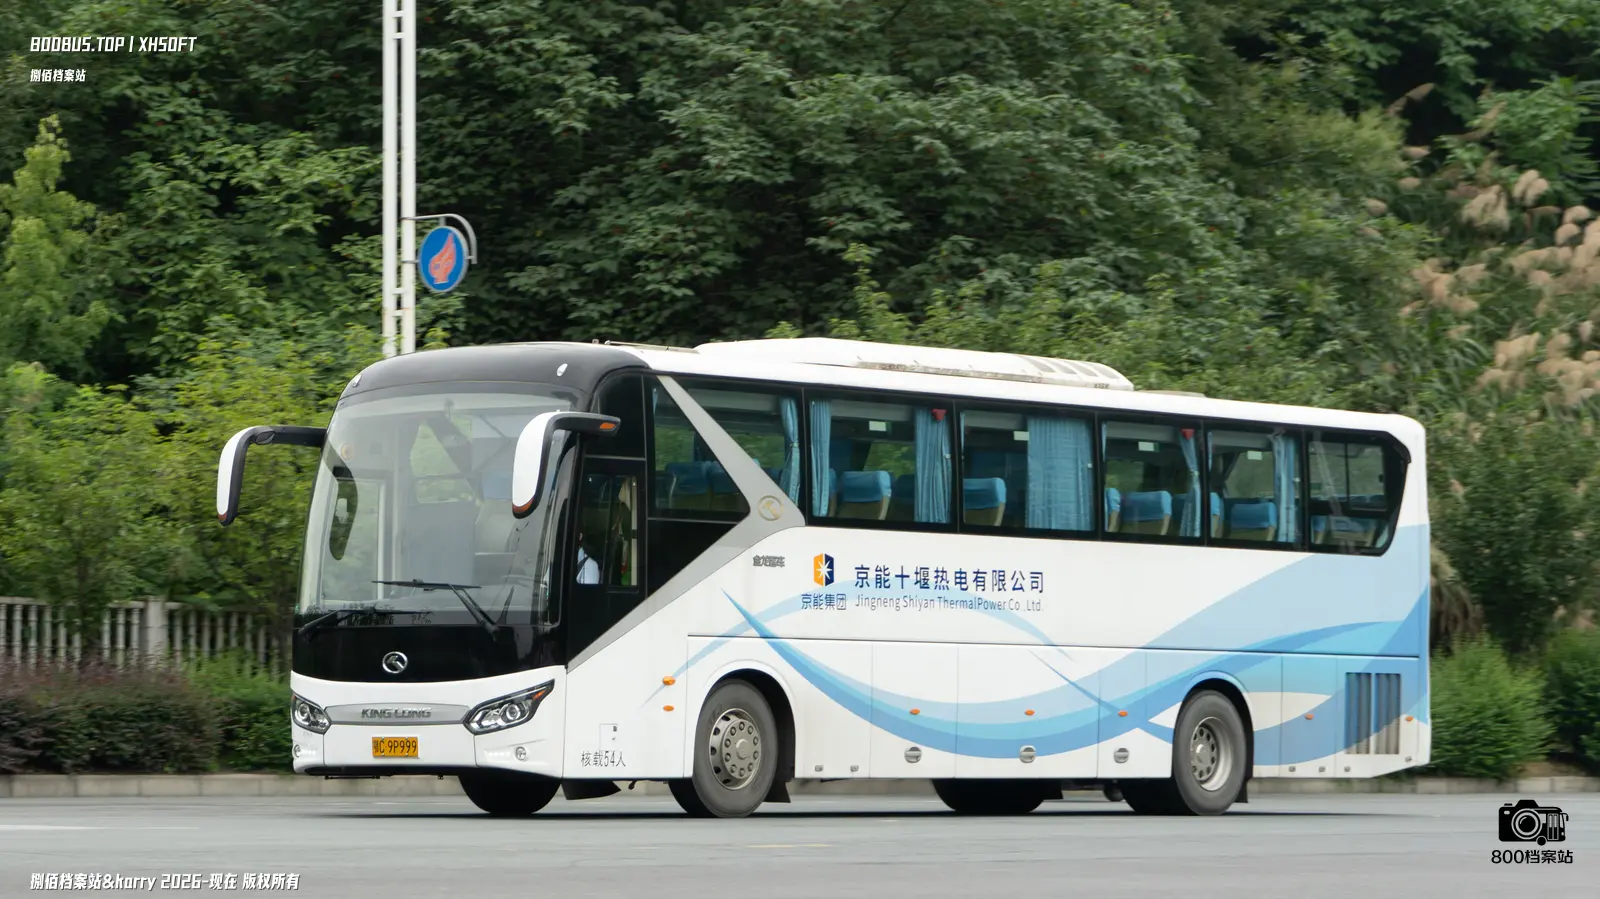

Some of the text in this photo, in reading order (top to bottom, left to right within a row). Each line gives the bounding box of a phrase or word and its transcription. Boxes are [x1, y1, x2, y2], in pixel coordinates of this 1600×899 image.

[854, 564, 1044, 593] 京能十堰热电有限公司
[800, 593, 847, 611] 京能集团
[855, 593, 901, 611] Jingneng
[902, 595, 935, 611] Shiyan
[361, 708, 431, 719] KING LONG
[580, 750, 627, 768] 核载54人
